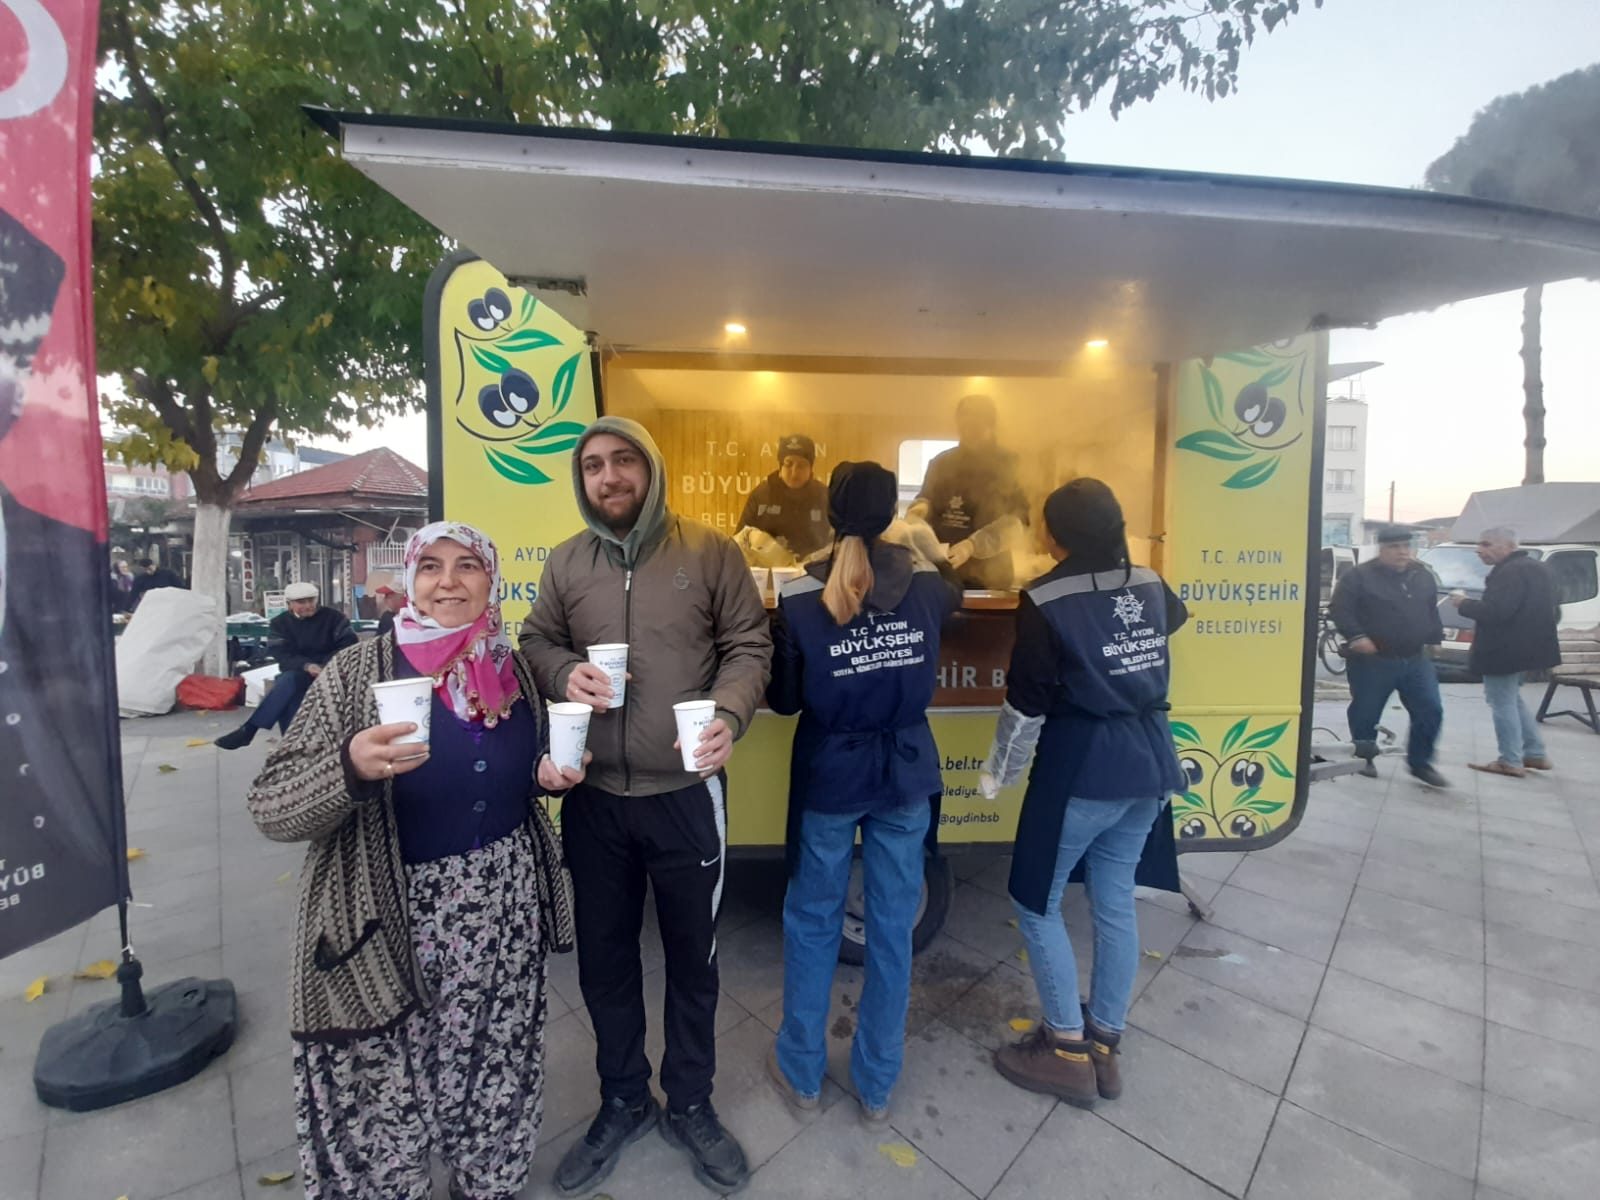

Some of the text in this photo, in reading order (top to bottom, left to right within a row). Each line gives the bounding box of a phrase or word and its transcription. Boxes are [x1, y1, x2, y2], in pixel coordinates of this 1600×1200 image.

[514, 546, 553, 562] AYD
[1237, 550, 1283, 564] AYDIN
[498, 577, 540, 604] ÜKŞ
[1180, 579, 1300, 607] BÜYÜKŞEHİR
[876, 620, 908, 634] AYDIN
[1196, 617, 1283, 635] BELEDİYESİ
[829, 627, 925, 657] BÜYÜKŞEHİR
[1102, 633, 1167, 657] BÜYÜKŞEHİR
[850, 646, 914, 666] BELEDİYESİ
[936, 661, 977, 688] HİR
[940, 755, 985, 770] .bel.tr
[938, 811, 1000, 825] @aydinbsb
